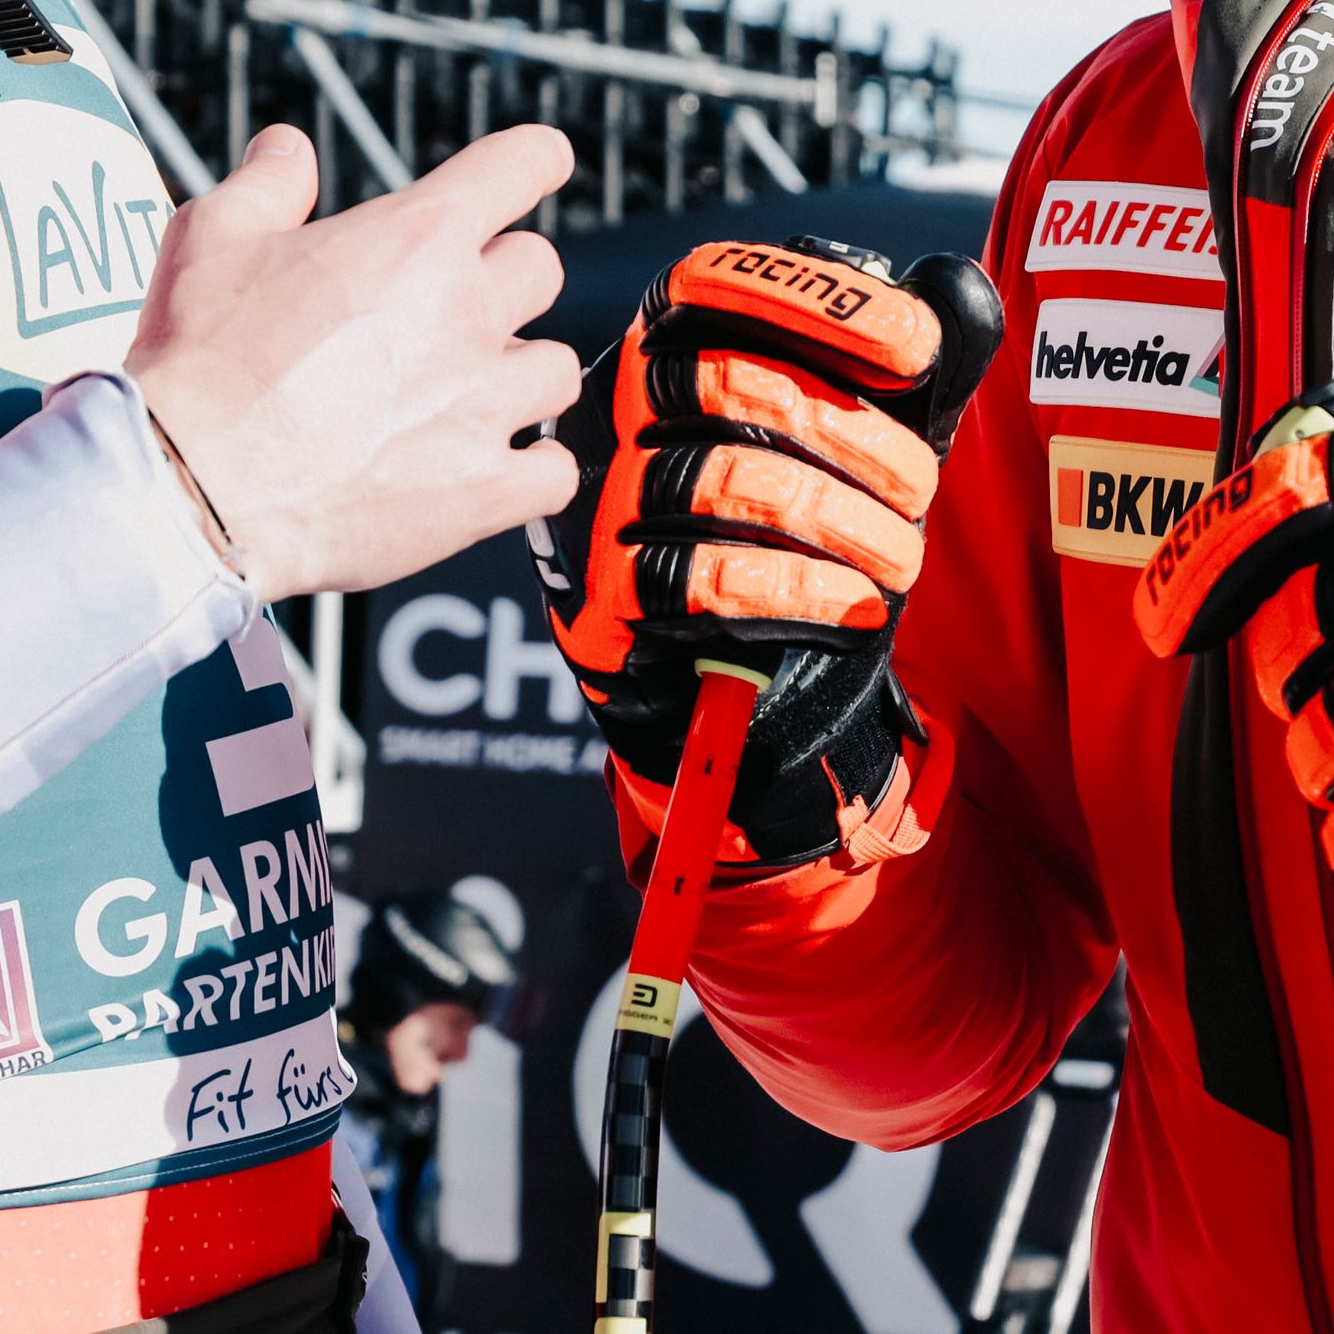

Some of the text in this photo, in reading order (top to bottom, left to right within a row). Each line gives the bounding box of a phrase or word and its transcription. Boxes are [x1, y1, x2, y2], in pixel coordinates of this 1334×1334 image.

[709, 247, 873, 321] racing
[1035, 330, 1190, 387] helvetia
[1086, 471, 1205, 538] BKW
[1144, 467, 1255, 607] racing
[378, 593, 593, 724] CH
[74, 818, 334, 978] GARMI
[186, 1048, 342, 1142] Fit fürs
